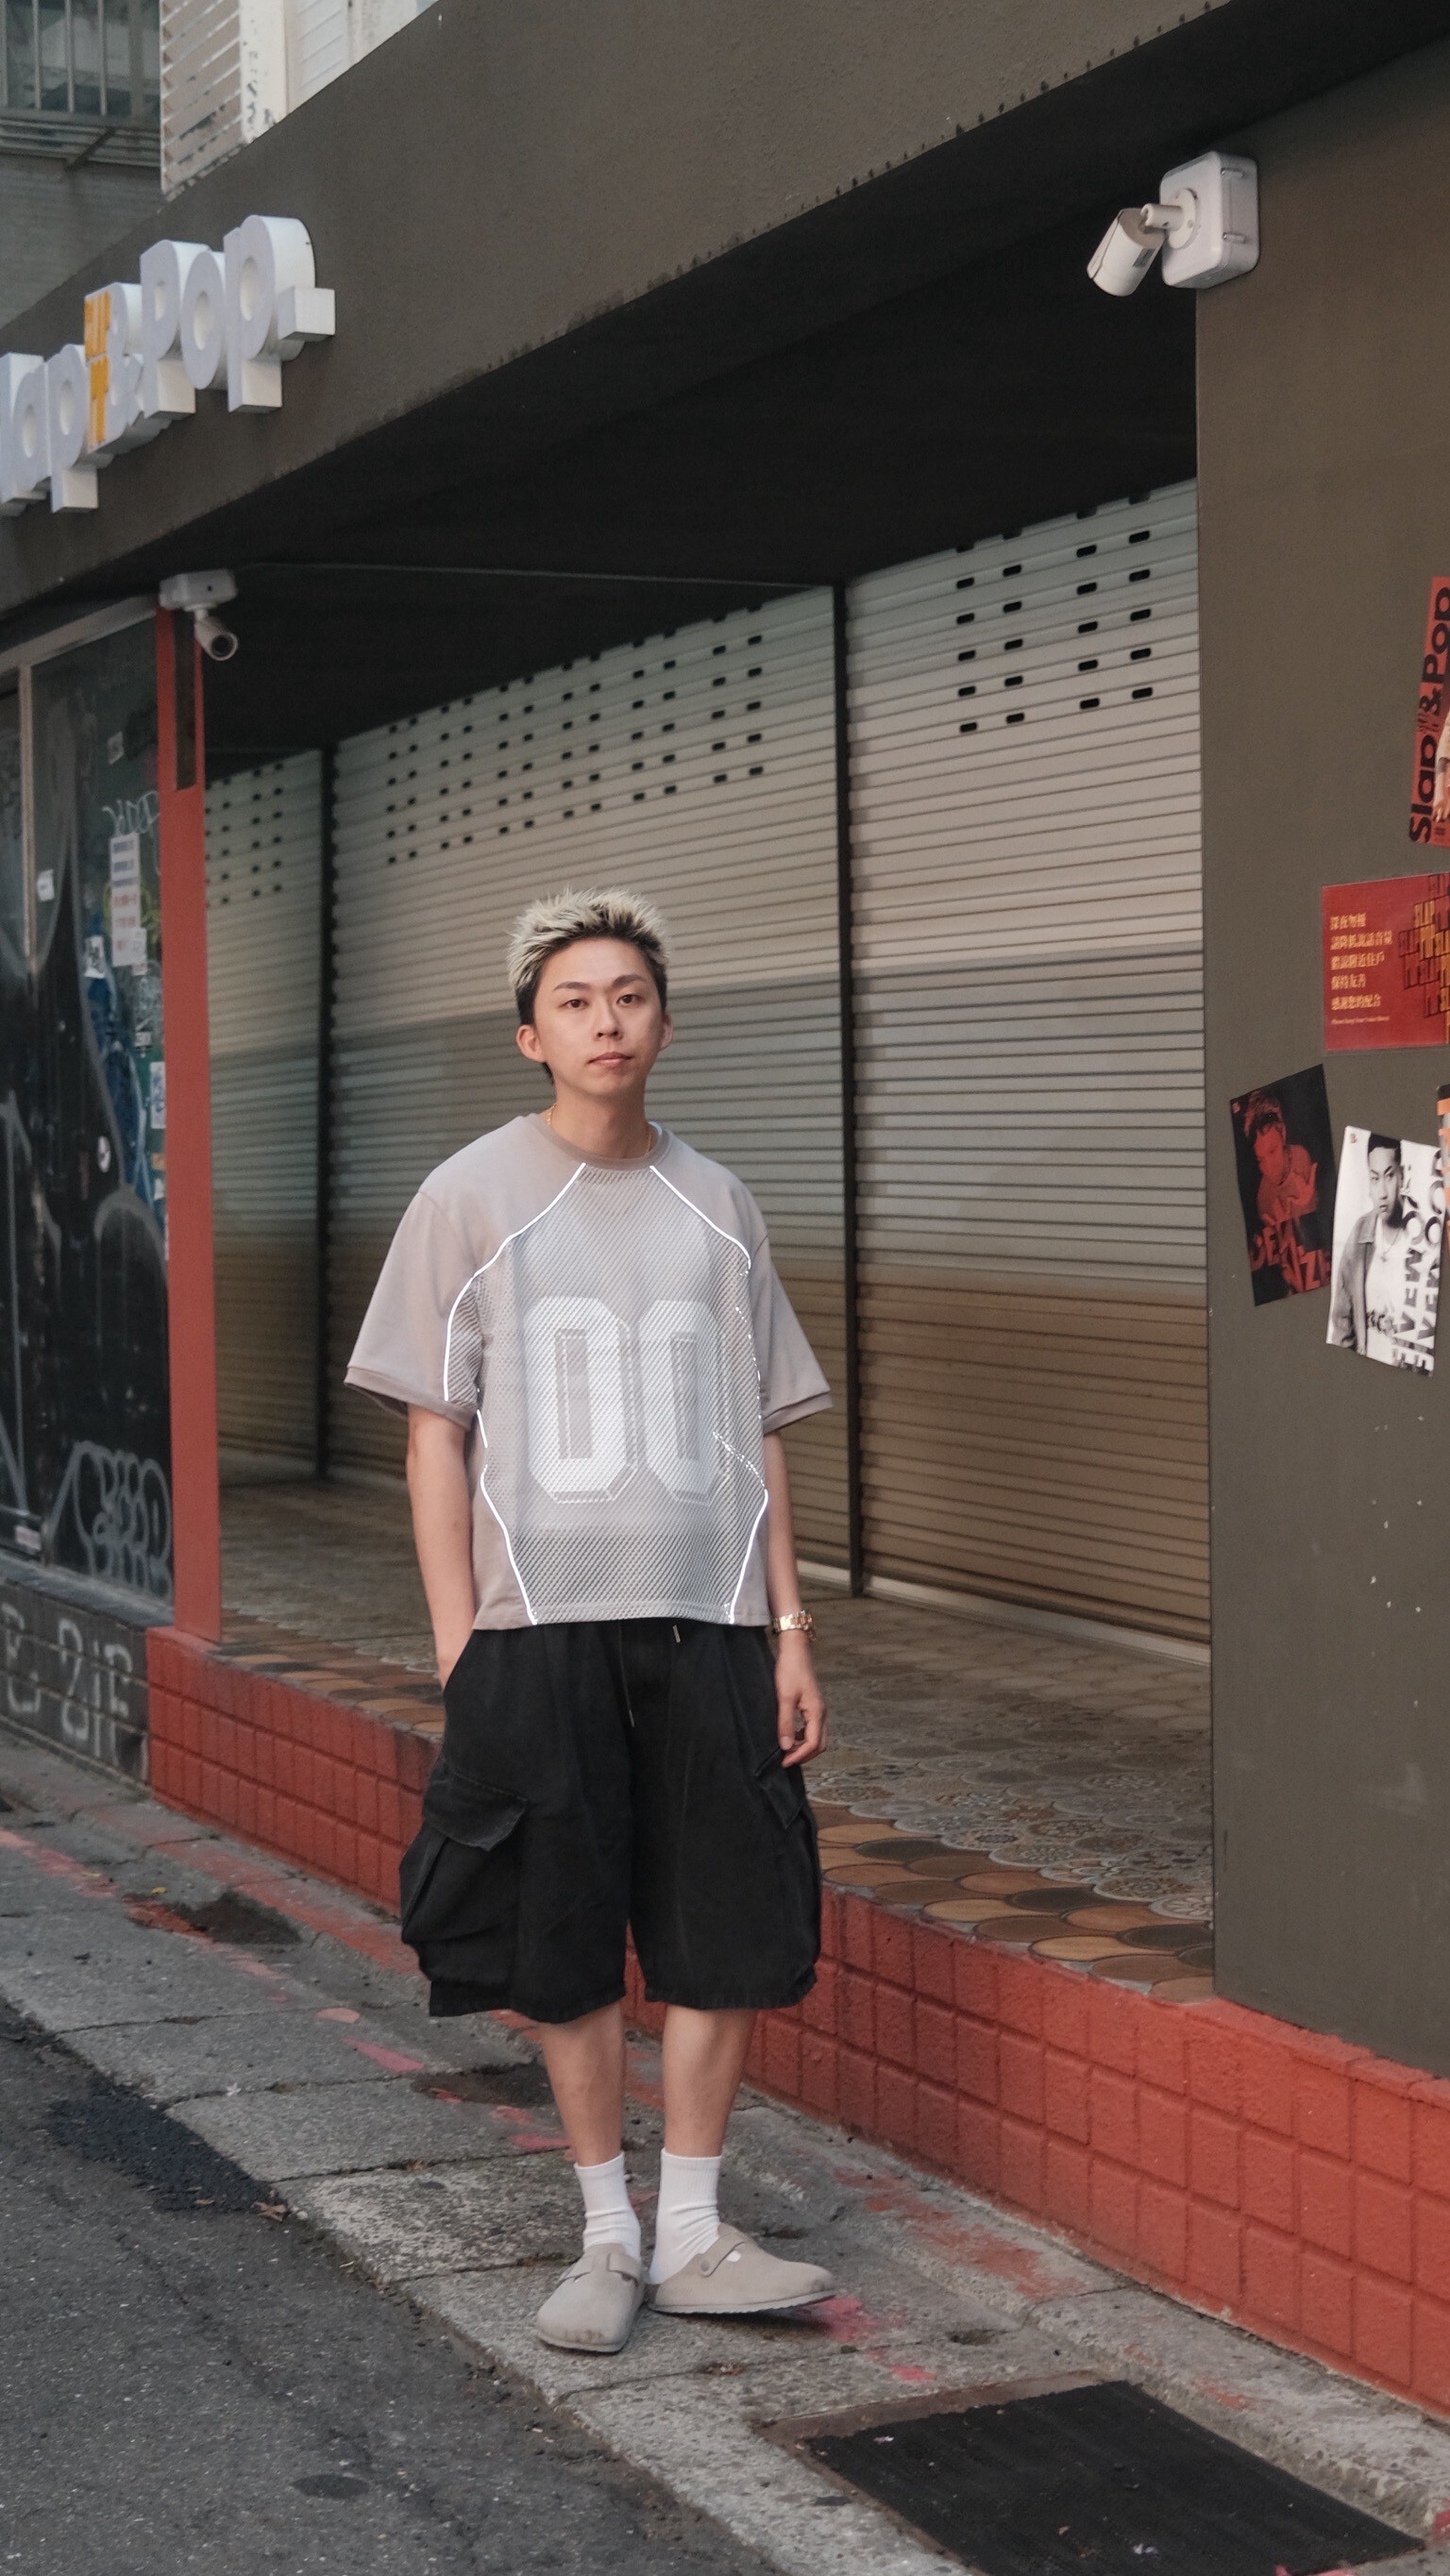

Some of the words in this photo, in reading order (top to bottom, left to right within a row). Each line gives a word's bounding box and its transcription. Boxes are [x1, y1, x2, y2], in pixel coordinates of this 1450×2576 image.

[1419, 688, 1442, 716] &
[1409, 735, 1436, 843] Slap
[522, 1296, 725, 1504] 00
